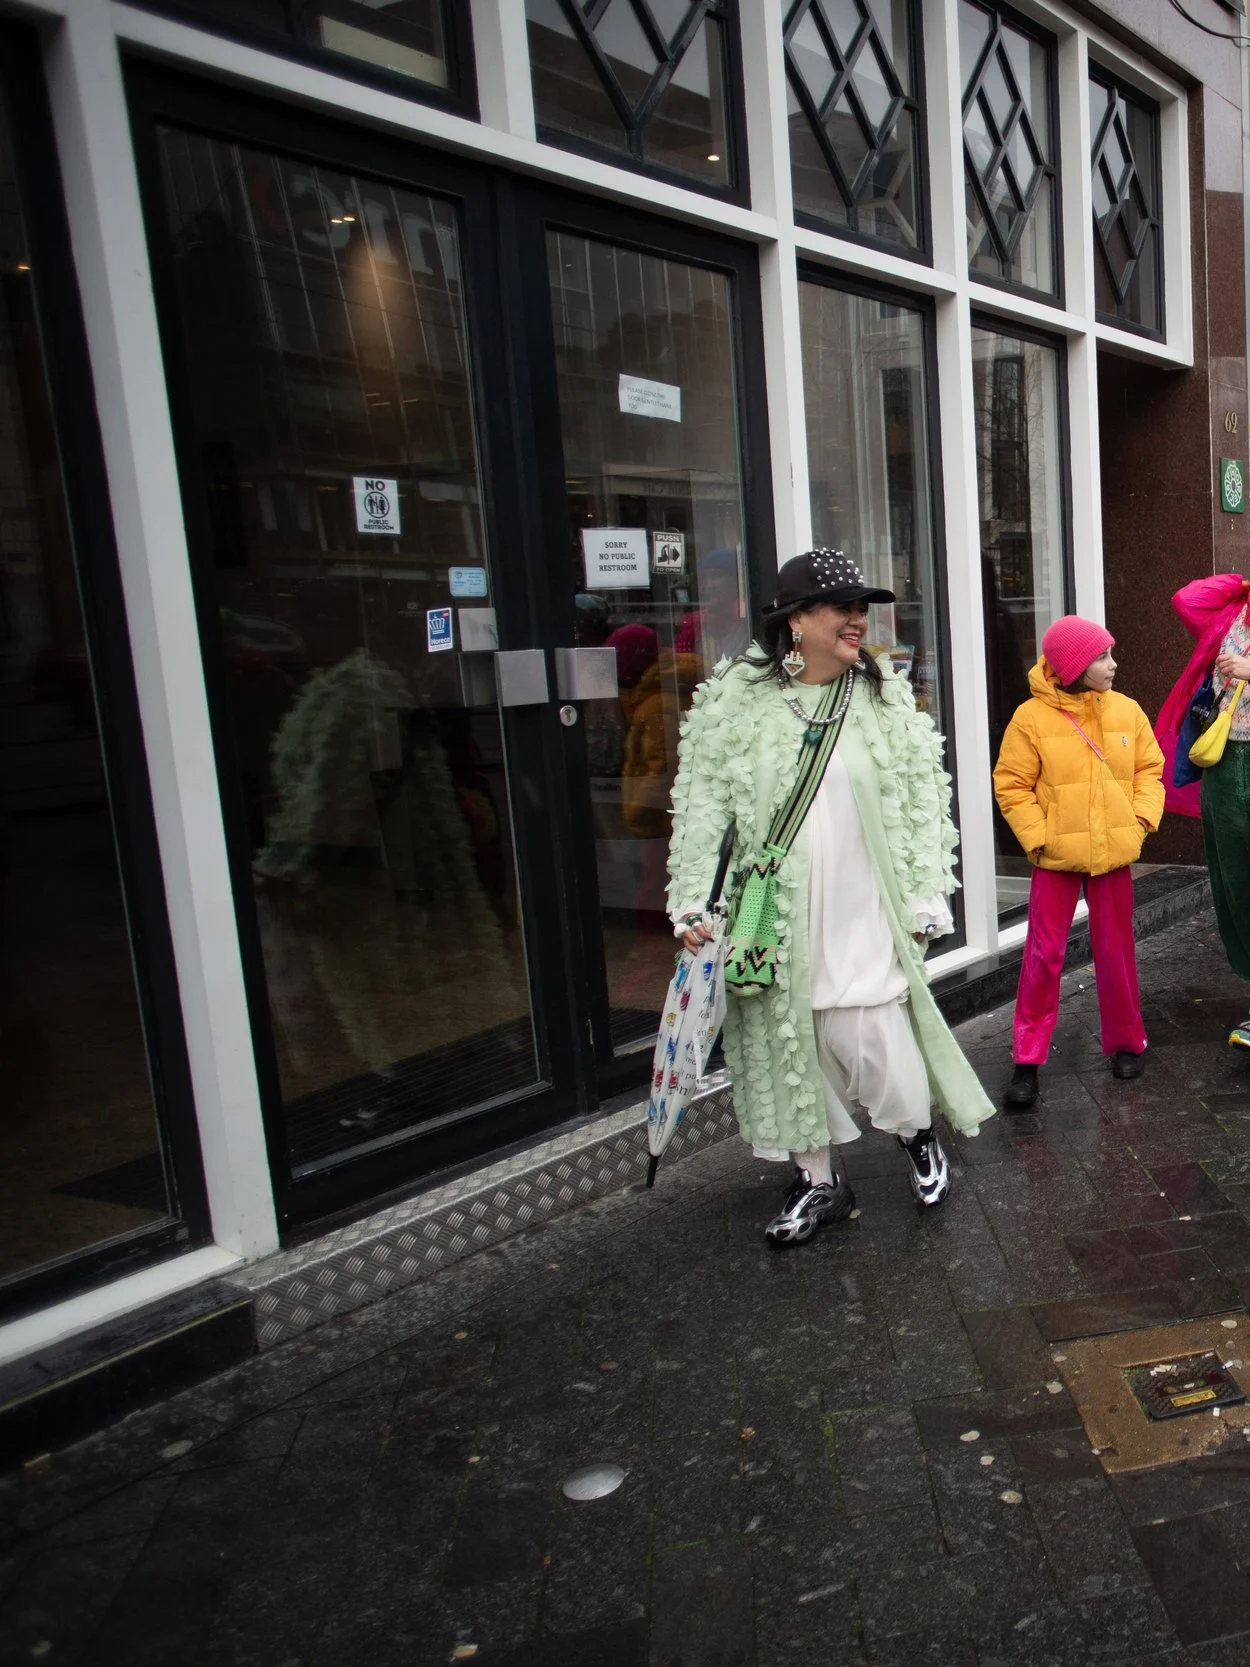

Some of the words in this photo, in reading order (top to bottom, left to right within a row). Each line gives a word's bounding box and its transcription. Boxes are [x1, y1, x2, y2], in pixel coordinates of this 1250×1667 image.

[1224, 410, 1238, 434] 62
[364, 479, 385, 491] NO
[657, 534, 680, 542] PUSH
[604, 541, 628, 549] SORRY
[611, 552, 636, 560] PUBLIC
[599, 564, 638, 572] RESTROOM
